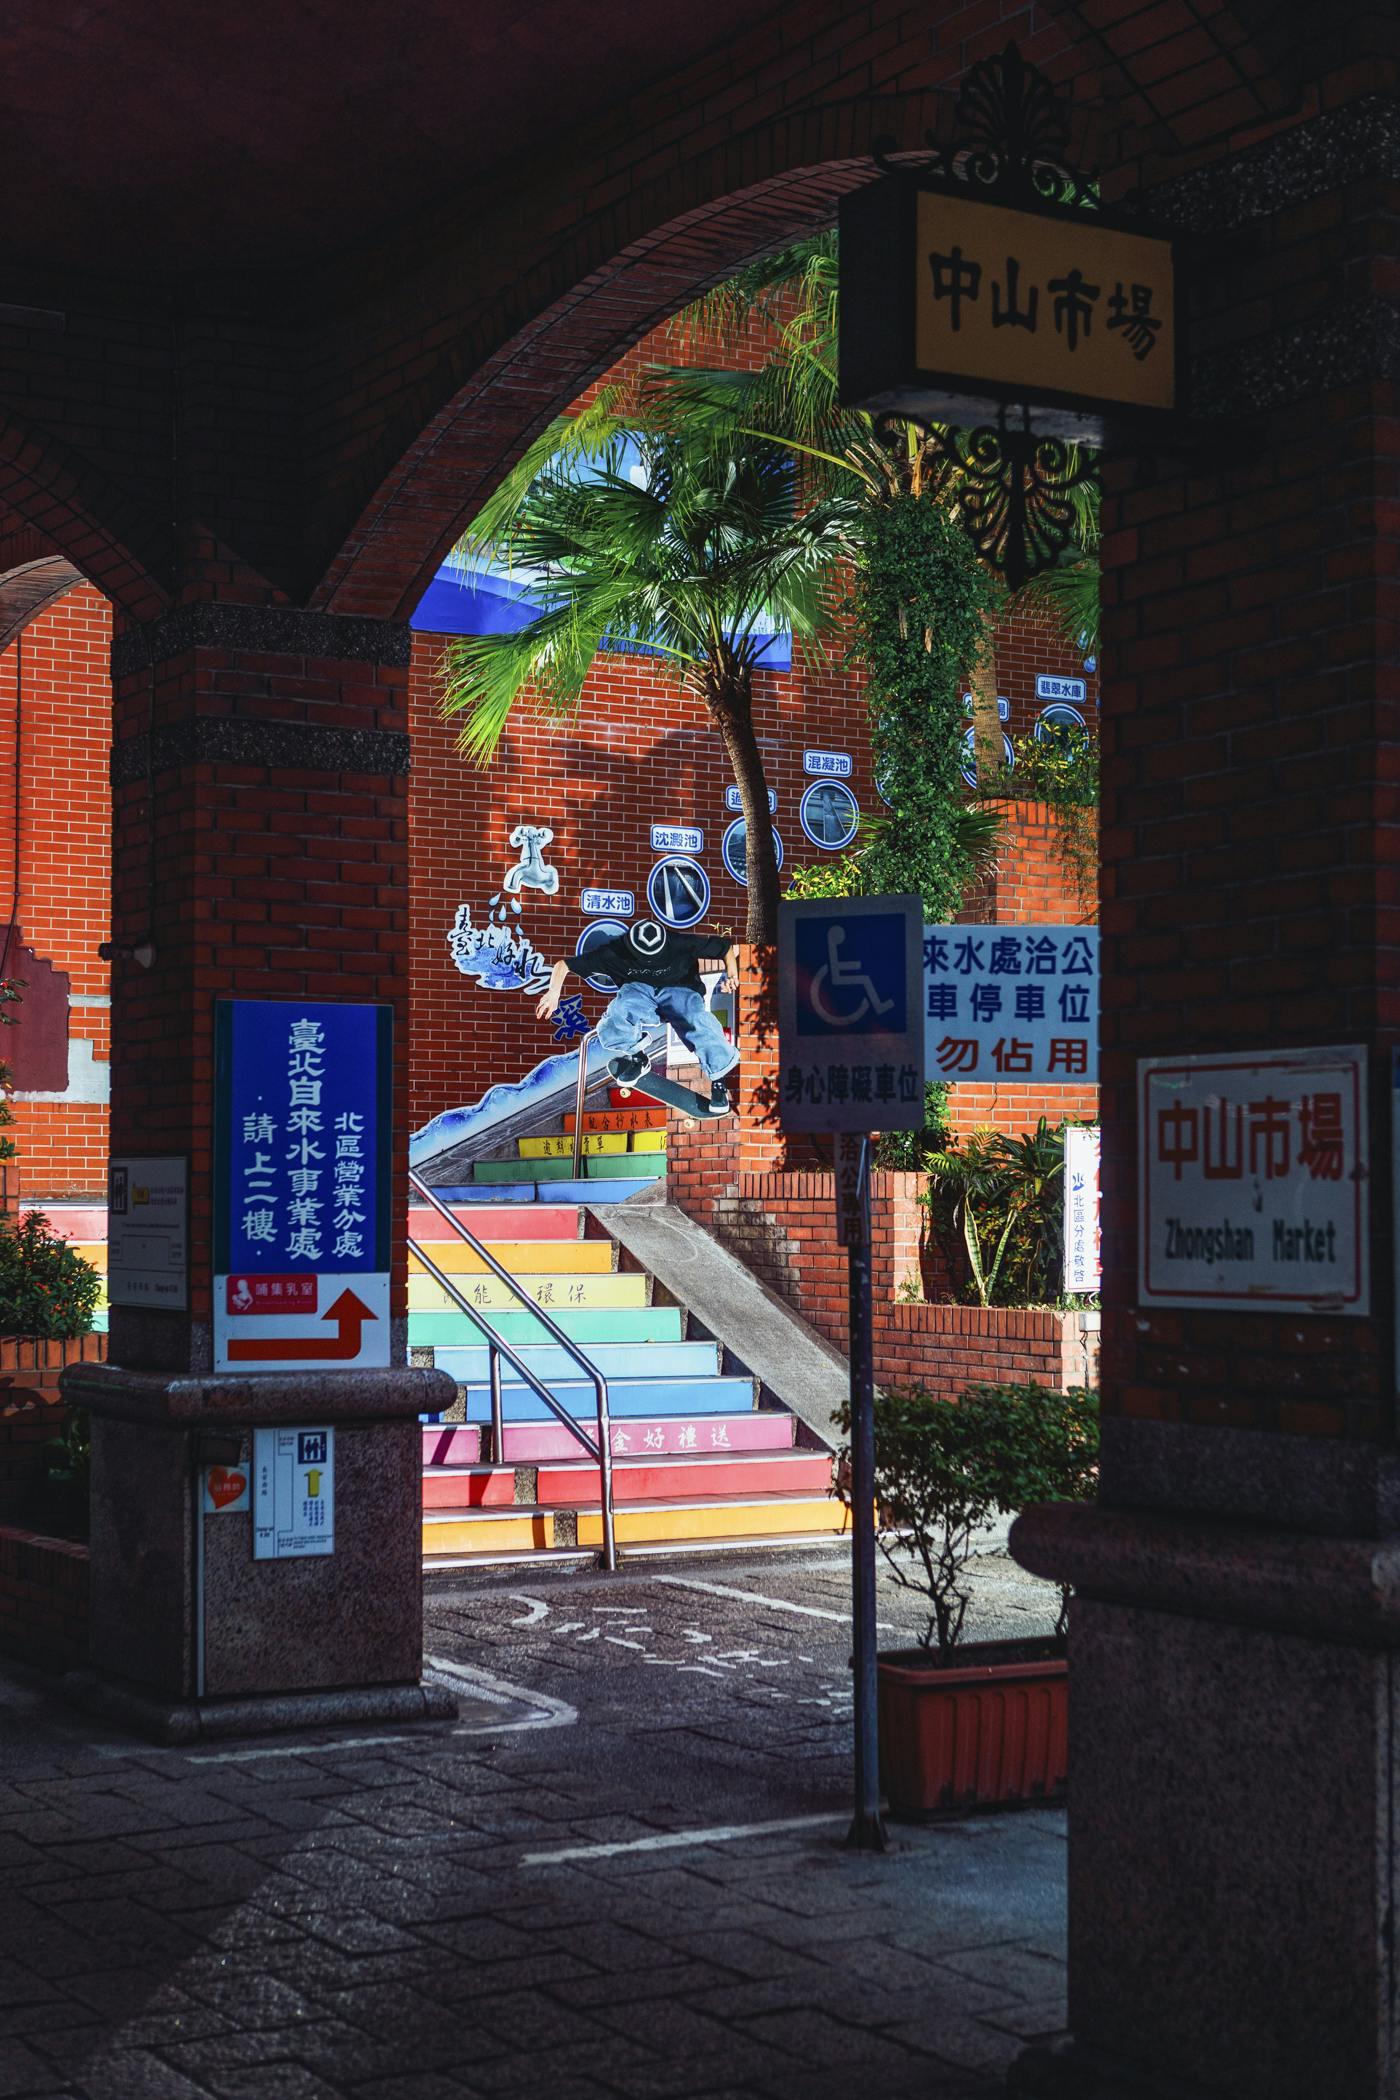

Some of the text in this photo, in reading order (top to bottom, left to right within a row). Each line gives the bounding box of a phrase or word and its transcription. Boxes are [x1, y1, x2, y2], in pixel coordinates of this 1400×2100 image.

[928, 247, 1161, 360] 中山市場
[1040, 680, 1082, 698] 翡翠水庫
[807, 755, 848, 772] 混凝池
[655, 831, 698, 848] 沈澱池
[586, 894, 631, 911] 清水池
[449, 906, 553, 980] 臺北好水
[935, 1036, 1088, 1074] 勿佔用
[785, 1063, 919, 1104] 身心障礙車位
[285, 1018, 327, 1260] 臺北自來水事業處
[1158, 1094, 1344, 1180] 中山市場
[240, 1112, 279, 1243] 請上二樓
[332, 1112, 366, 1258] 北區營業分處
[1165, 1217, 1337, 1265] Zhongshan Market
[443, 1283, 587, 1304] 能環保
